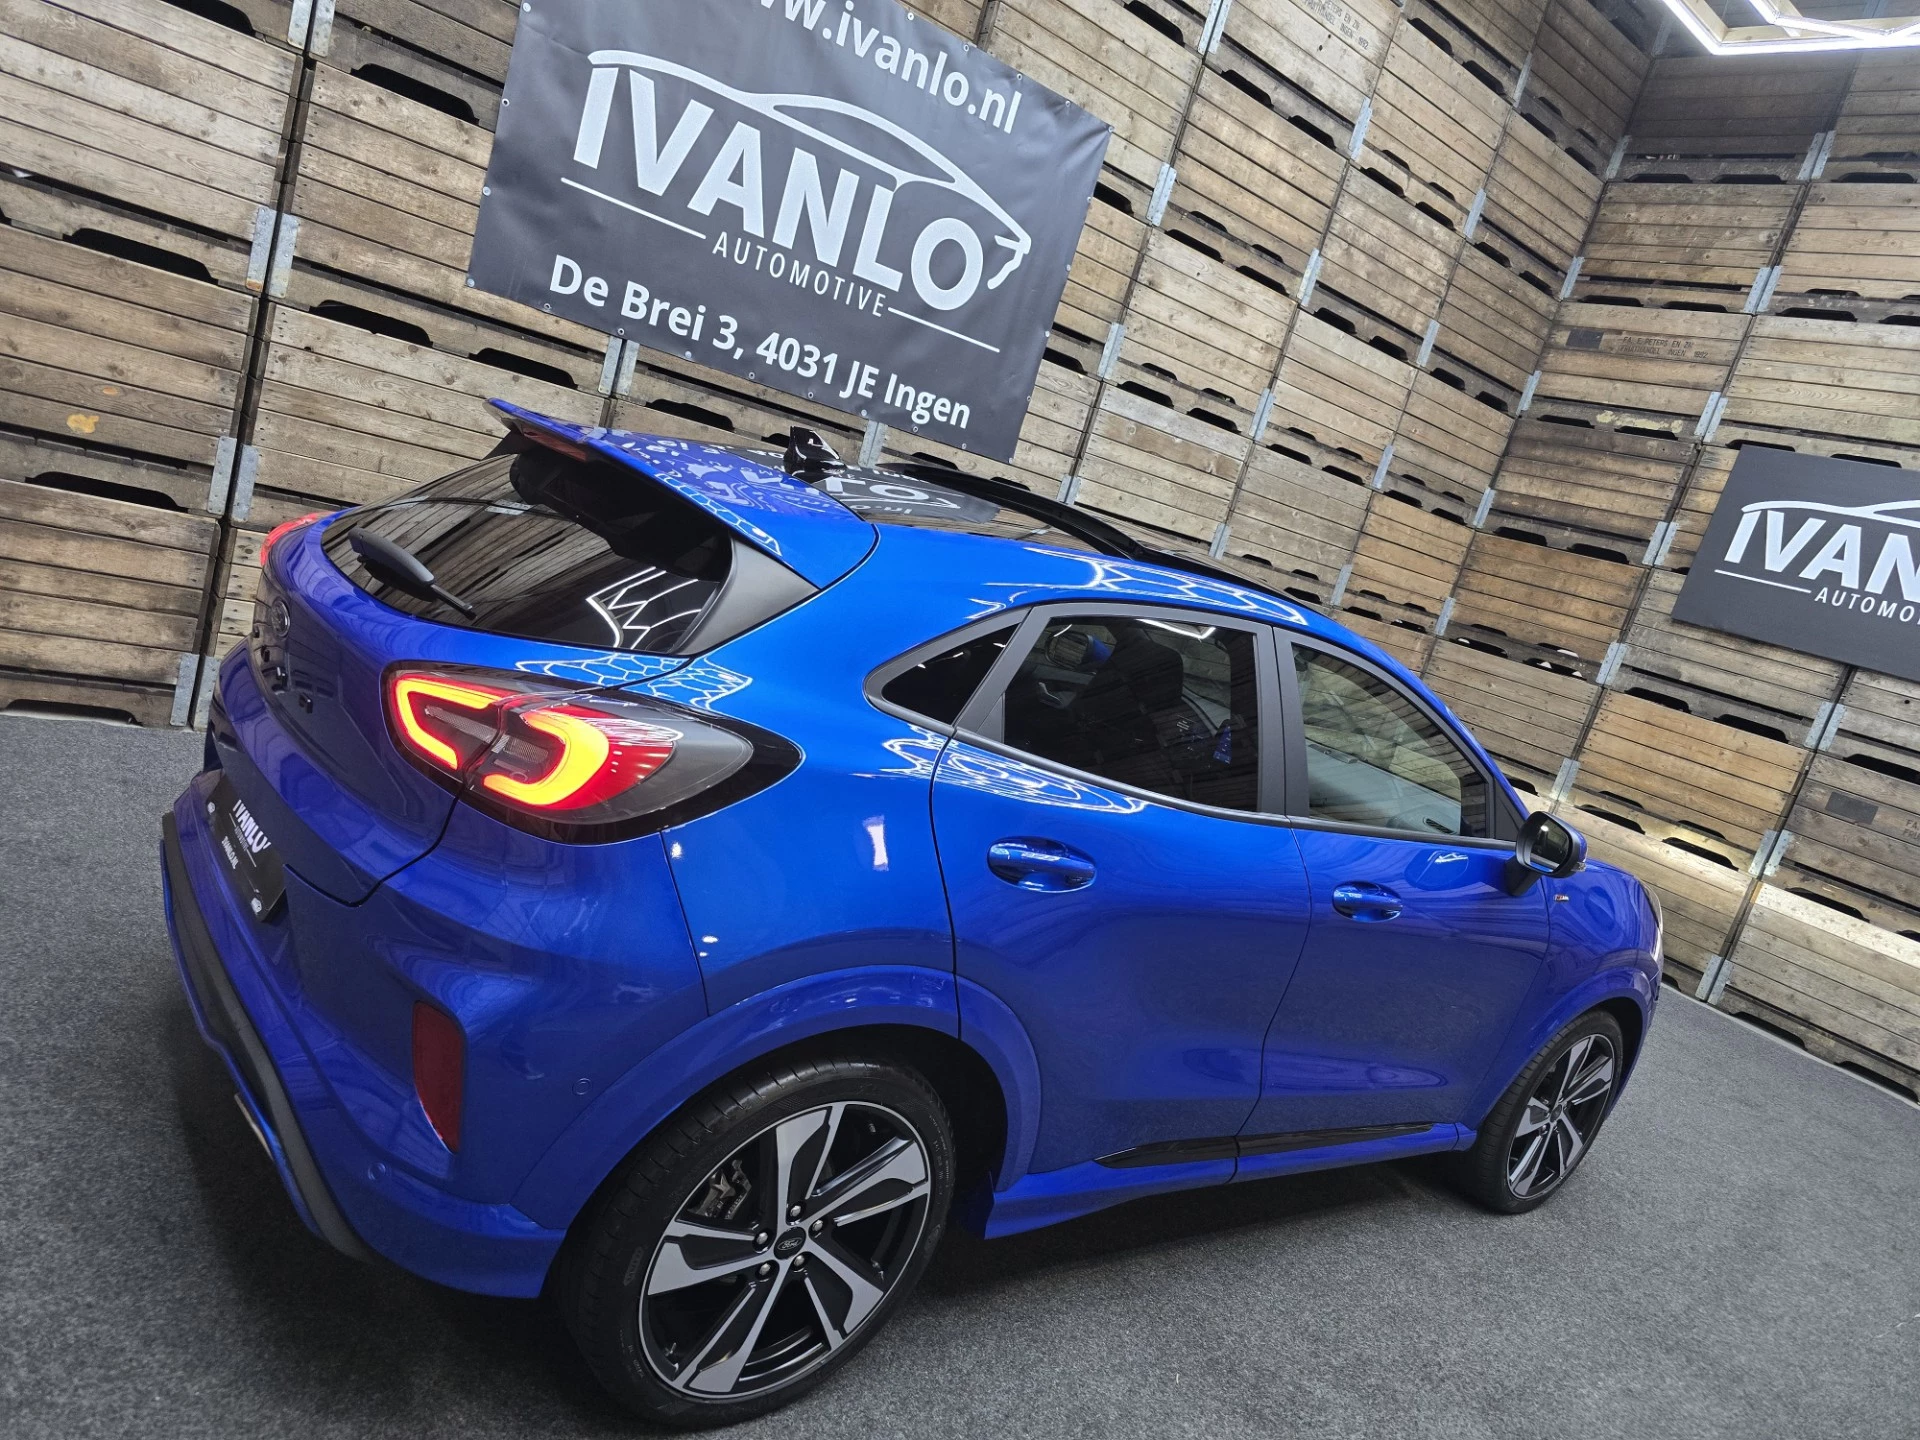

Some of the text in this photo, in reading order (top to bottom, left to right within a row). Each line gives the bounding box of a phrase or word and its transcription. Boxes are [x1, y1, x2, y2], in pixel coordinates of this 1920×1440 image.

[757, 0, 1022, 134] w.ivanlo.nl
[573, 67, 983, 310] IVANLO
[712, 231, 887, 318] AUTOMOTIVE
[549, 254, 971, 430] De Brei 3, 4031 JE Ingen
[1644, 338, 1669, 347] PETERS
